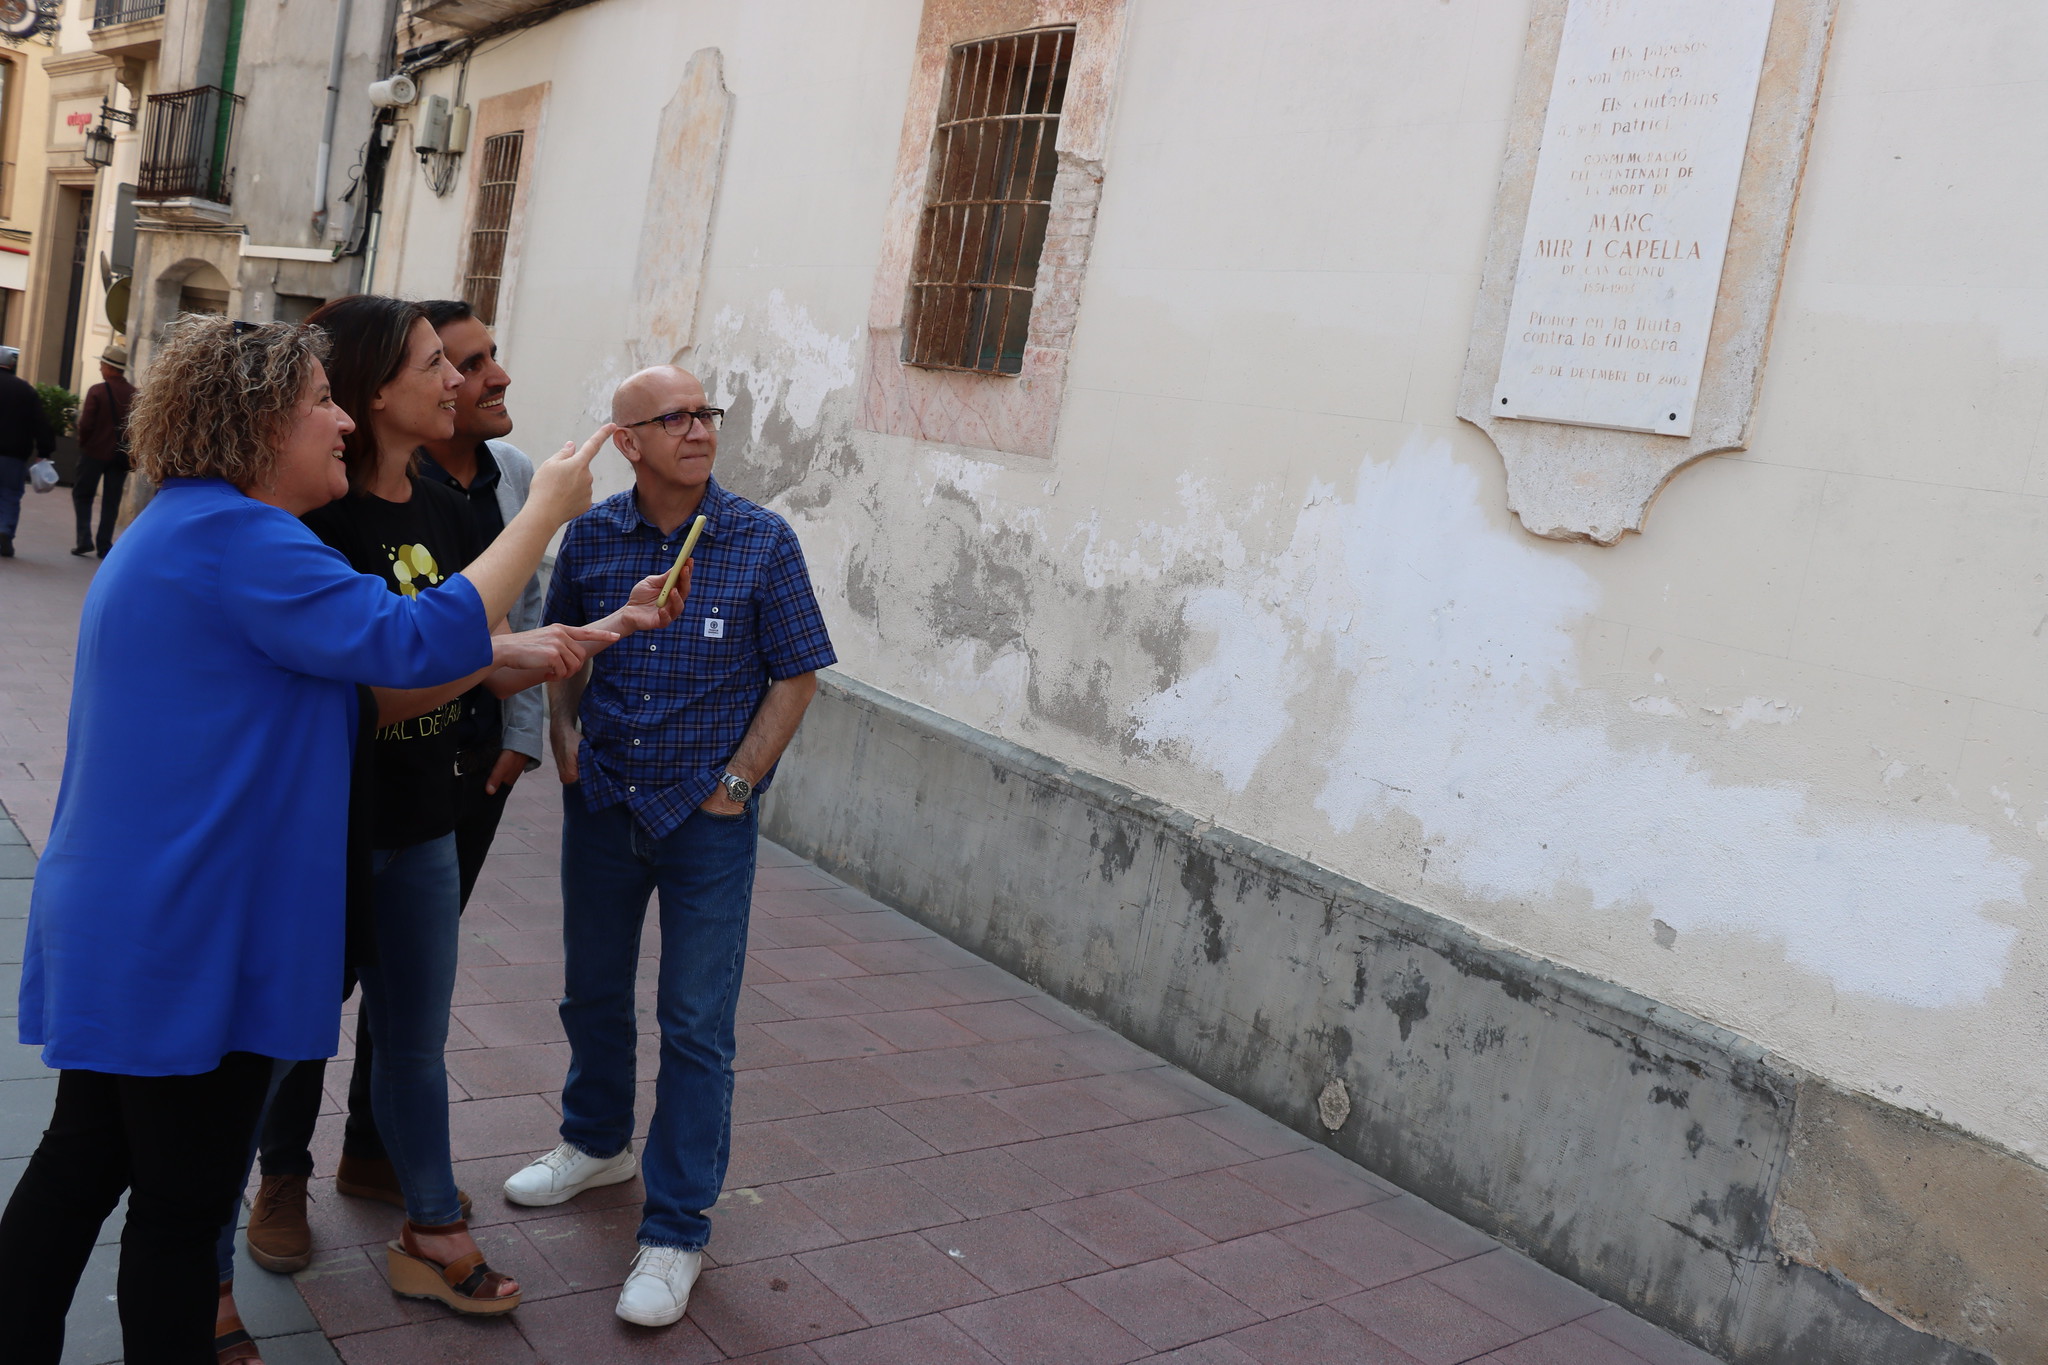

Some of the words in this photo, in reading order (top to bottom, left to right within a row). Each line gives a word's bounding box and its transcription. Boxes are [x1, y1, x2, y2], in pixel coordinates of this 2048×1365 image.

[1678, 166, 1694, 178] DE
[1609, 184, 1645, 196] MORT
[1588, 213, 1654, 232] MARC
[1535, 240, 1573, 258] MIR
[1586, 240, 1592, 258] I
[1605, 240, 1701, 260] CAPELLA
[1530, 311, 1577, 328] Pioner
[1585, 317, 1604, 328] en
[1614, 317, 1627, 330] la
[1636, 316, 1681, 333] lluita
[1582, 332, 1596, 347] la
[1550, 366, 1563, 377] DE
[1637, 372, 1650, 383] DE
